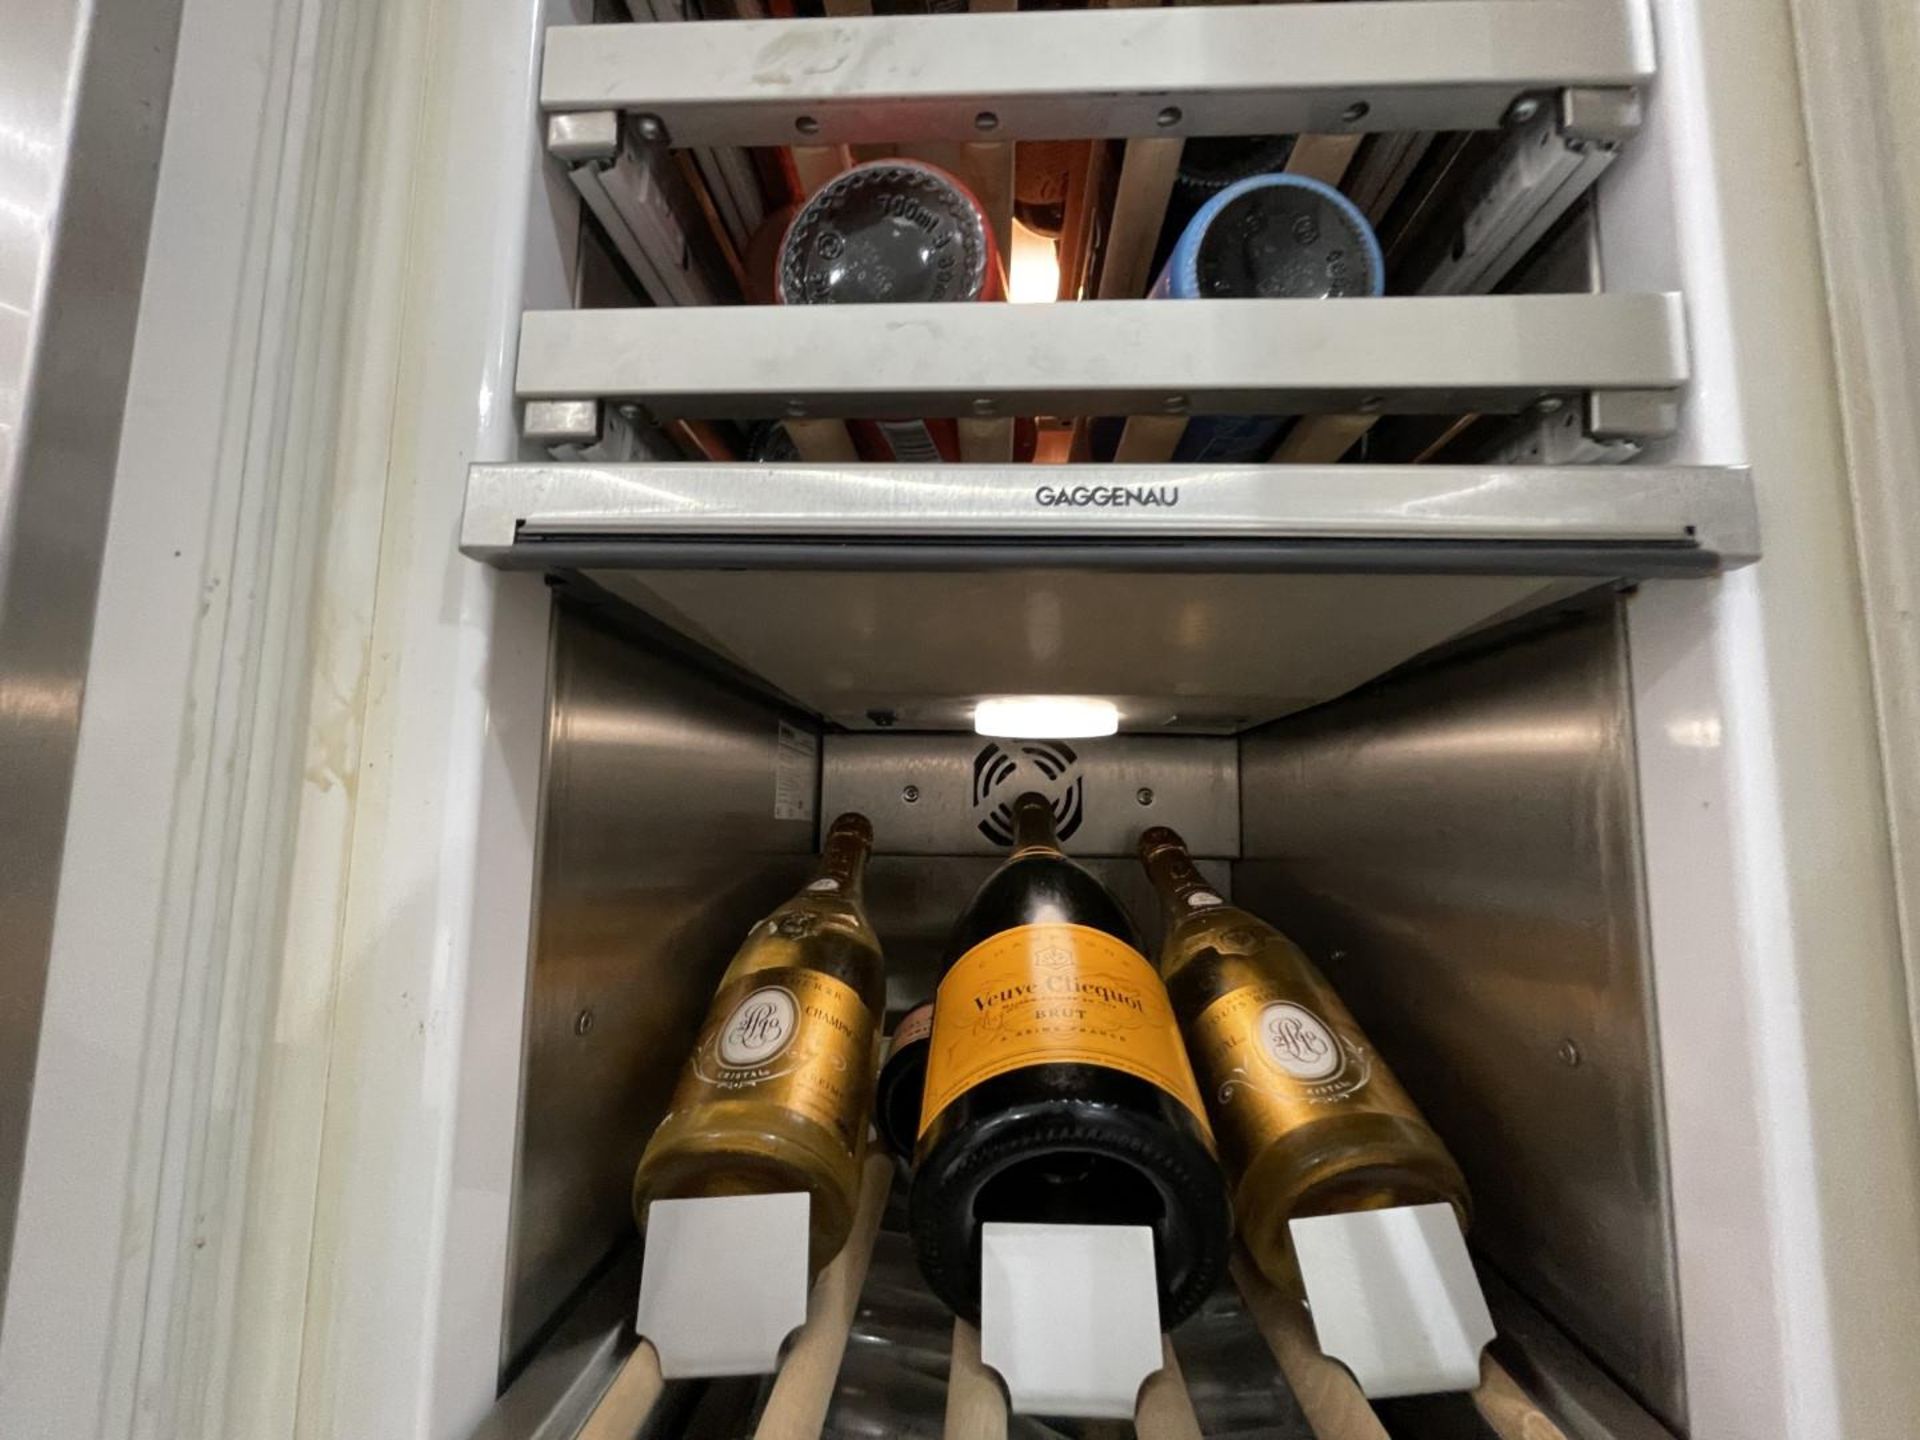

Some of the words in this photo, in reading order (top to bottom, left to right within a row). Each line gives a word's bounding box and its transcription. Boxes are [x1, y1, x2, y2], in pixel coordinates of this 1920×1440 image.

[1035, 485, 1179, 507] GAGGENAU
[973, 981, 1039, 1012] Veuve
[1045, 974, 1145, 1014] Clicquot
[1035, 1007, 1088, 1020] BRUT
